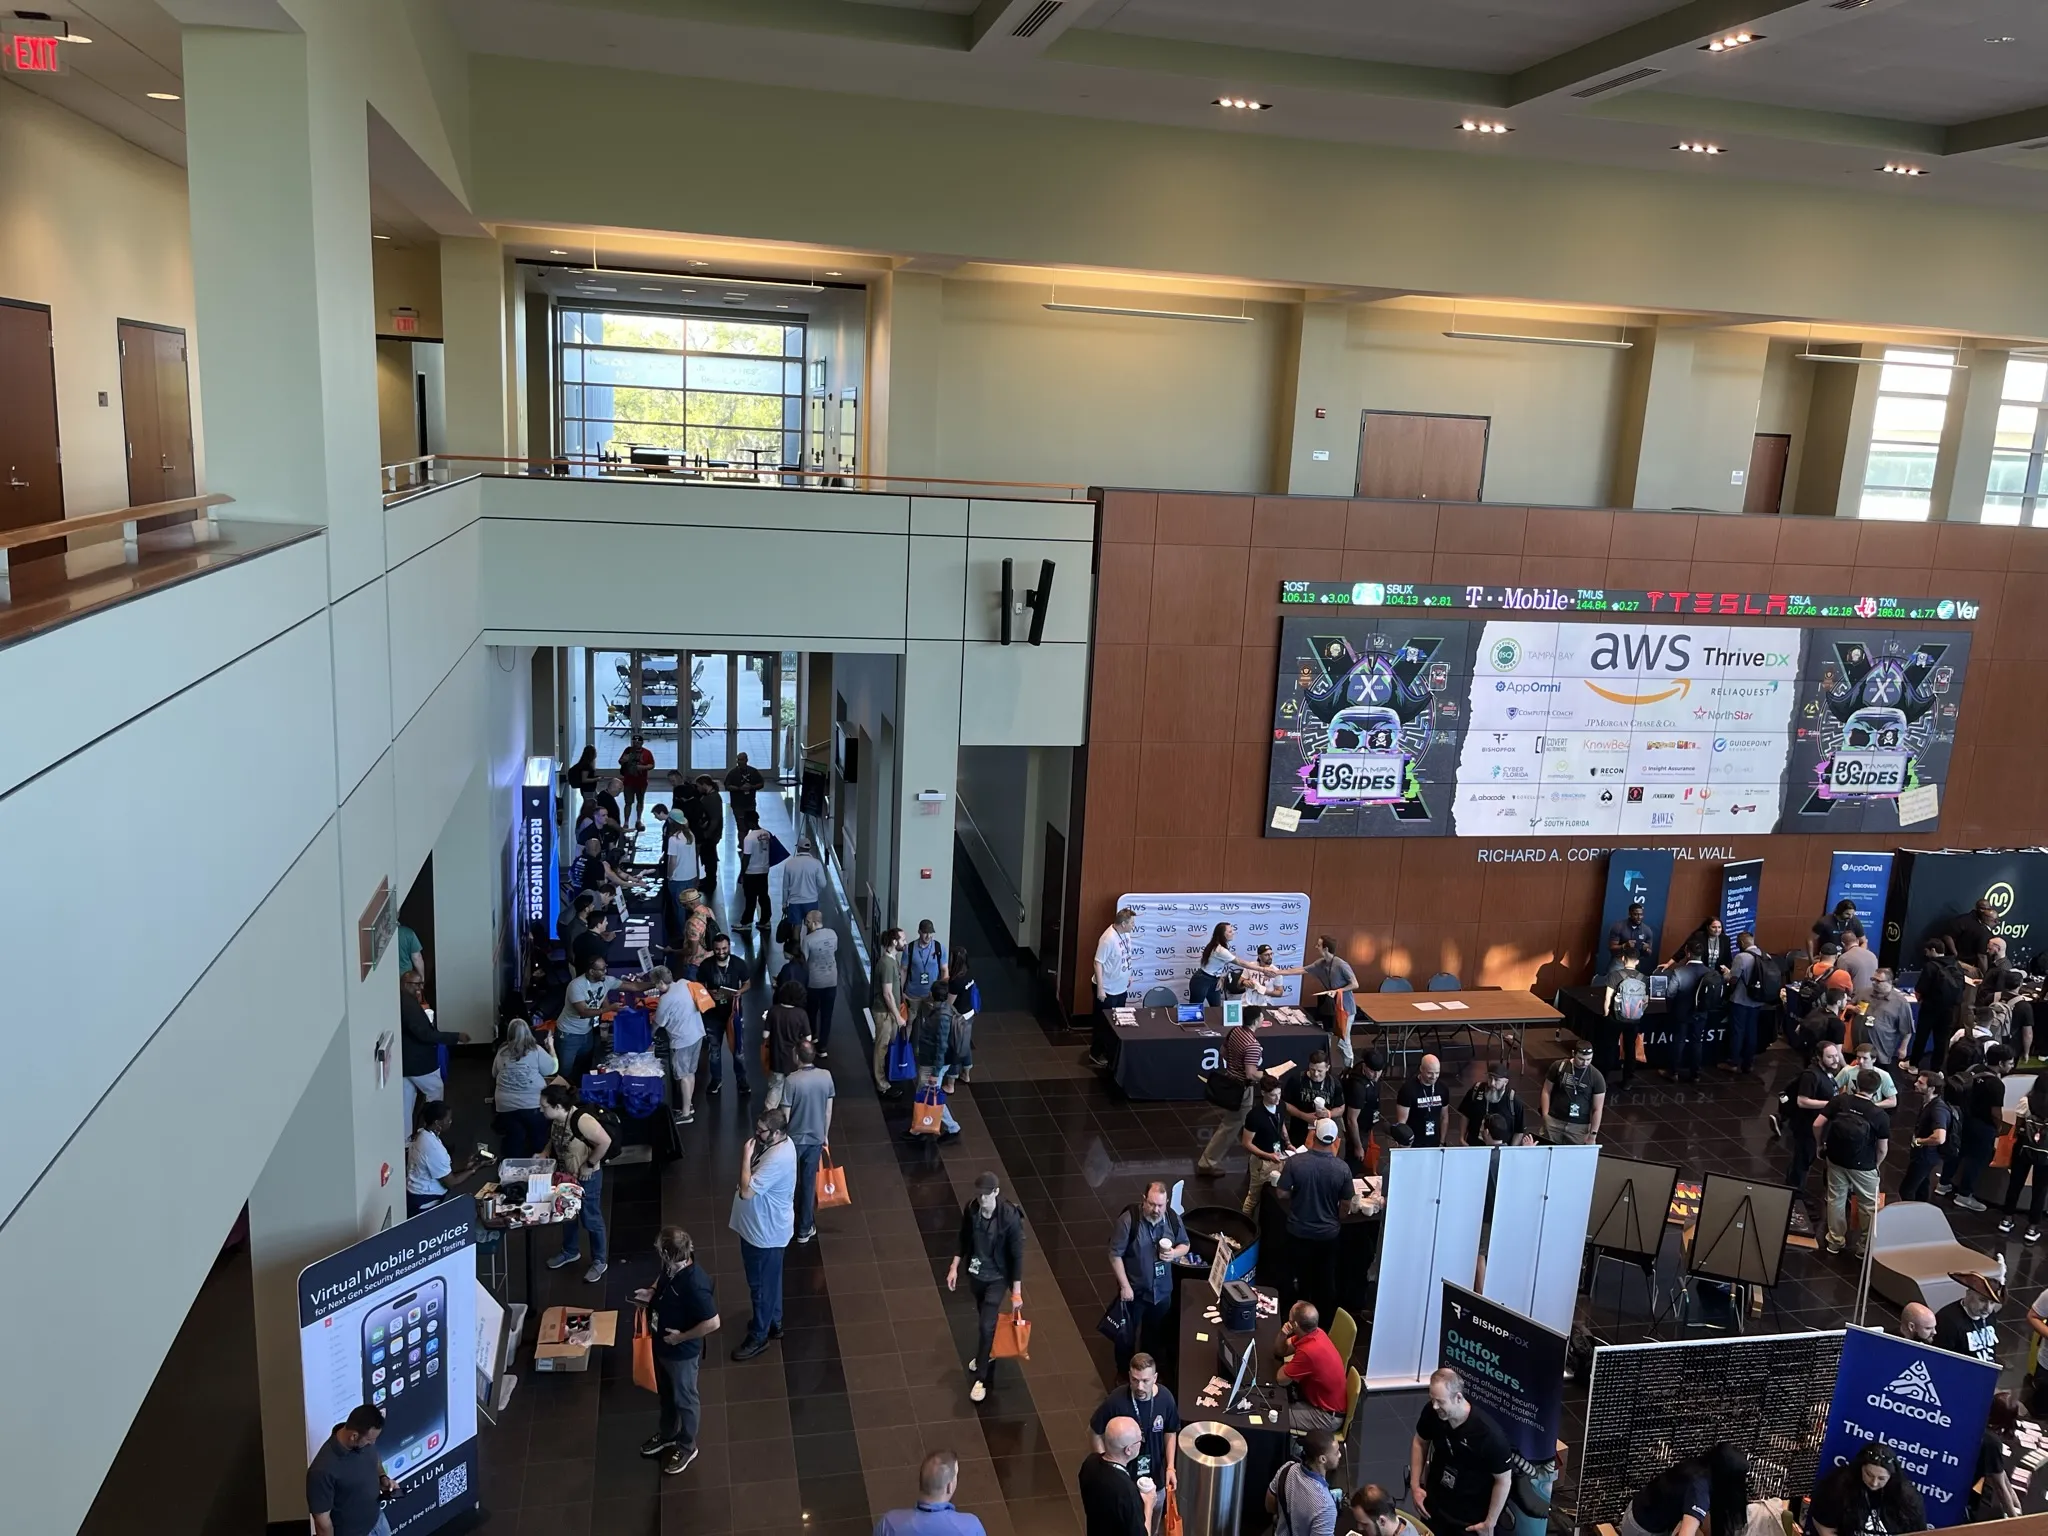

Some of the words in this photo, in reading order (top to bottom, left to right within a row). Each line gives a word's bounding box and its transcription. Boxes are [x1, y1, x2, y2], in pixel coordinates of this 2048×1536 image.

[14, 35, 59, 71] EXIT
[1283, 582, 1310, 592] ROST
[1386, 584, 1414, 594] SBUX
[1282, 592, 1315, 603] 106.13
[1328, 594, 1350, 604] 3.00
[1386, 595, 1419, 605] 104.13
[1431, 597, 1452, 606] 2.81
[1578, 590, 1604, 599] TMUS
[1789, 595, 1811, 605] TSLA
[1576, 600, 1607, 610] 144.84
[1619, 602, 1640, 611] 0.27
[1668, 592, 1788, 615] TESLA
[1879, 598, 1897, 607] TXN
[1787, 605, 1817, 616] 207.46
[1828, 606, 1853, 616] 12.18
[1877, 607, 1906, 618] 186.01
[1916, 609, 1936, 618] 1.77
[1527, 651, 1556, 660] TAMPA
[1558, 652, 1575, 660] BAY
[1590, 632, 1692, 672] aws
[1703, 647, 1790, 667] ThriveDX
[1357, 675, 1380, 700] X
[1506, 682, 1561, 694] AppOmni
[1711, 688, 1771, 697] RELIAQUEST
[1871, 678, 1889, 703] X
[1708, 710, 1753, 720] NorthStar
[1583, 739, 1630, 750] KnowBe4
[1354, 766, 1397, 774] TAMPA
[1863, 762, 1899, 770] TAMPA
[1651, 812, 1675, 825] BAWLS
[530, 818, 543, 868] RECON
[1477, 848, 1547, 863] RICHARD
[1549, 848, 1563, 862] A.
[1698, 847, 1736, 860] WALL
[1849, 864, 1882, 872] AppOmni
[530, 870, 543, 920] INFOSEC
[1127, 903, 1146, 911] aws
[1158, 903, 1178, 911] aws
[1189, 903, 1209, 911] aws
[1220, 902, 1240, 910] aws
[1250, 902, 1271, 910] aws
[1188, 924, 1208, 932] aws
[1249, 923, 1269, 931] aws
[1156, 946, 1175, 954] aws
[1155, 968, 1174, 976] aws
[311, 1271, 361, 1305] Virtual
[365, 1248, 415, 1280] Mobile
[419, 1222, 469, 1254] Devices
[315, 1307, 327, 1317] for
[328, 1297, 347, 1310] Next
[347, 1289, 363, 1300] Gen
[364, 1273, 394, 1292] Security
[395, 1257, 427, 1277] Research
[428, 1249, 441, 1260] and
[443, 1238, 466, 1253] Testing
[1472, 1315, 1529, 1349] BISHOPFOX
[1447, 1329, 1500, 1366] Outfox
[1445, 1345, 1525, 1393] attackers.
[1444, 1360, 1480, 1383] Continuous
[1480, 1380, 1511, 1399] offensive
[1511, 1395, 1539, 1412] security
[1472, 1383, 1502, 1403] designed
[1511, 1403, 1537, 1419] protect
[1471, 1390, 1498, 1409] dynamic
[1500, 1406, 1545, 1432] environments
[1866, 1393, 1952, 1428] abacode
[1843, 1420, 1875, 1441] The
[1878, 1431, 1939, 1460] Leader
[1941, 1450, 1959, 1466] in
[413, 1510, 425, 1520] free
[425, 1501, 437, 1513] trial
